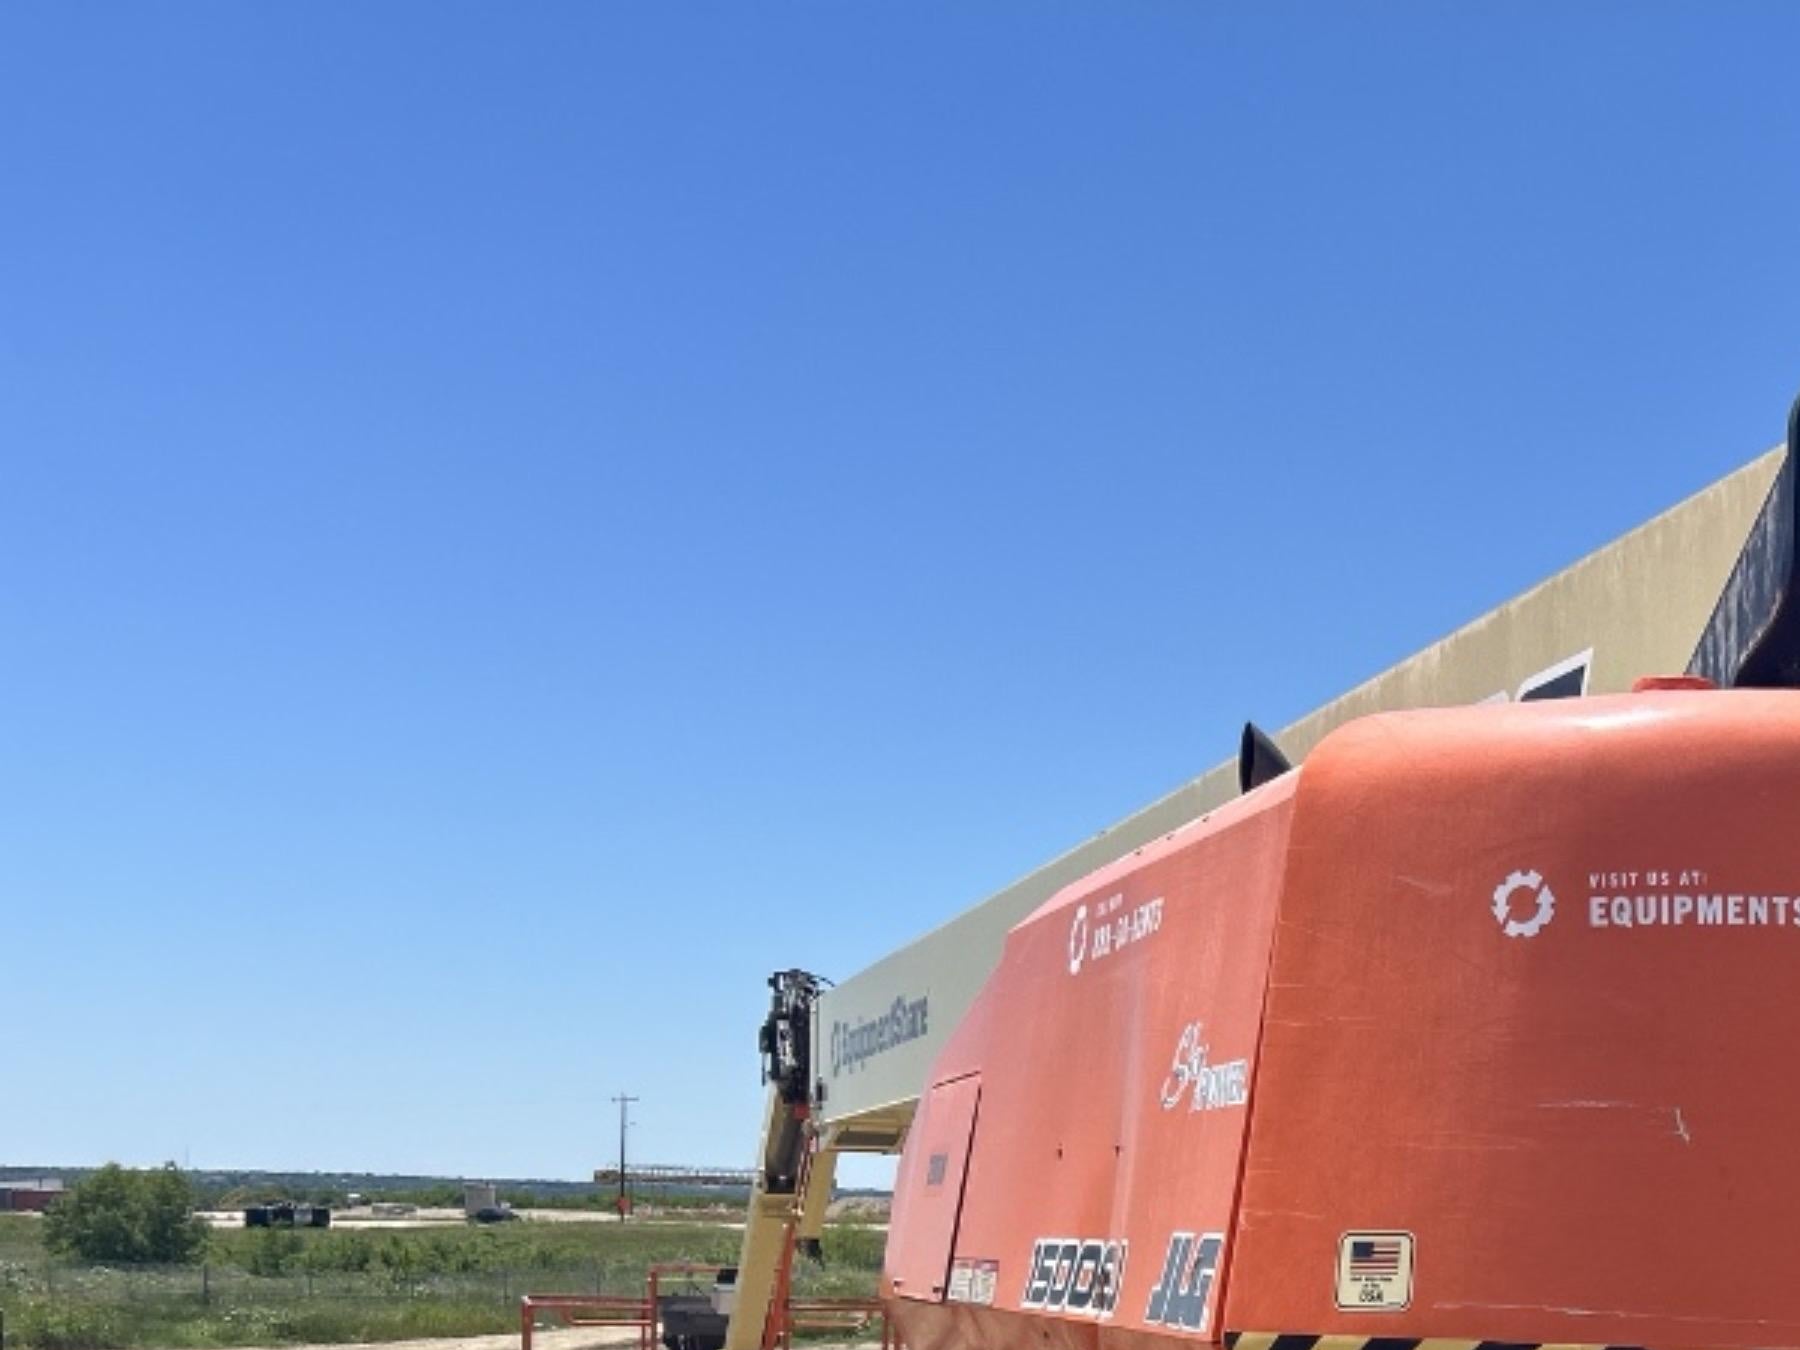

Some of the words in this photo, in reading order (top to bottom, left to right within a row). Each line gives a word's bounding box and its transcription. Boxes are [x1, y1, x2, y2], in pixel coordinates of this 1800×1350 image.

[1588, 871, 1639, 889] VISIT
[1646, 870, 1670, 887] US
[1143, 1231, 1226, 1333] JLG
